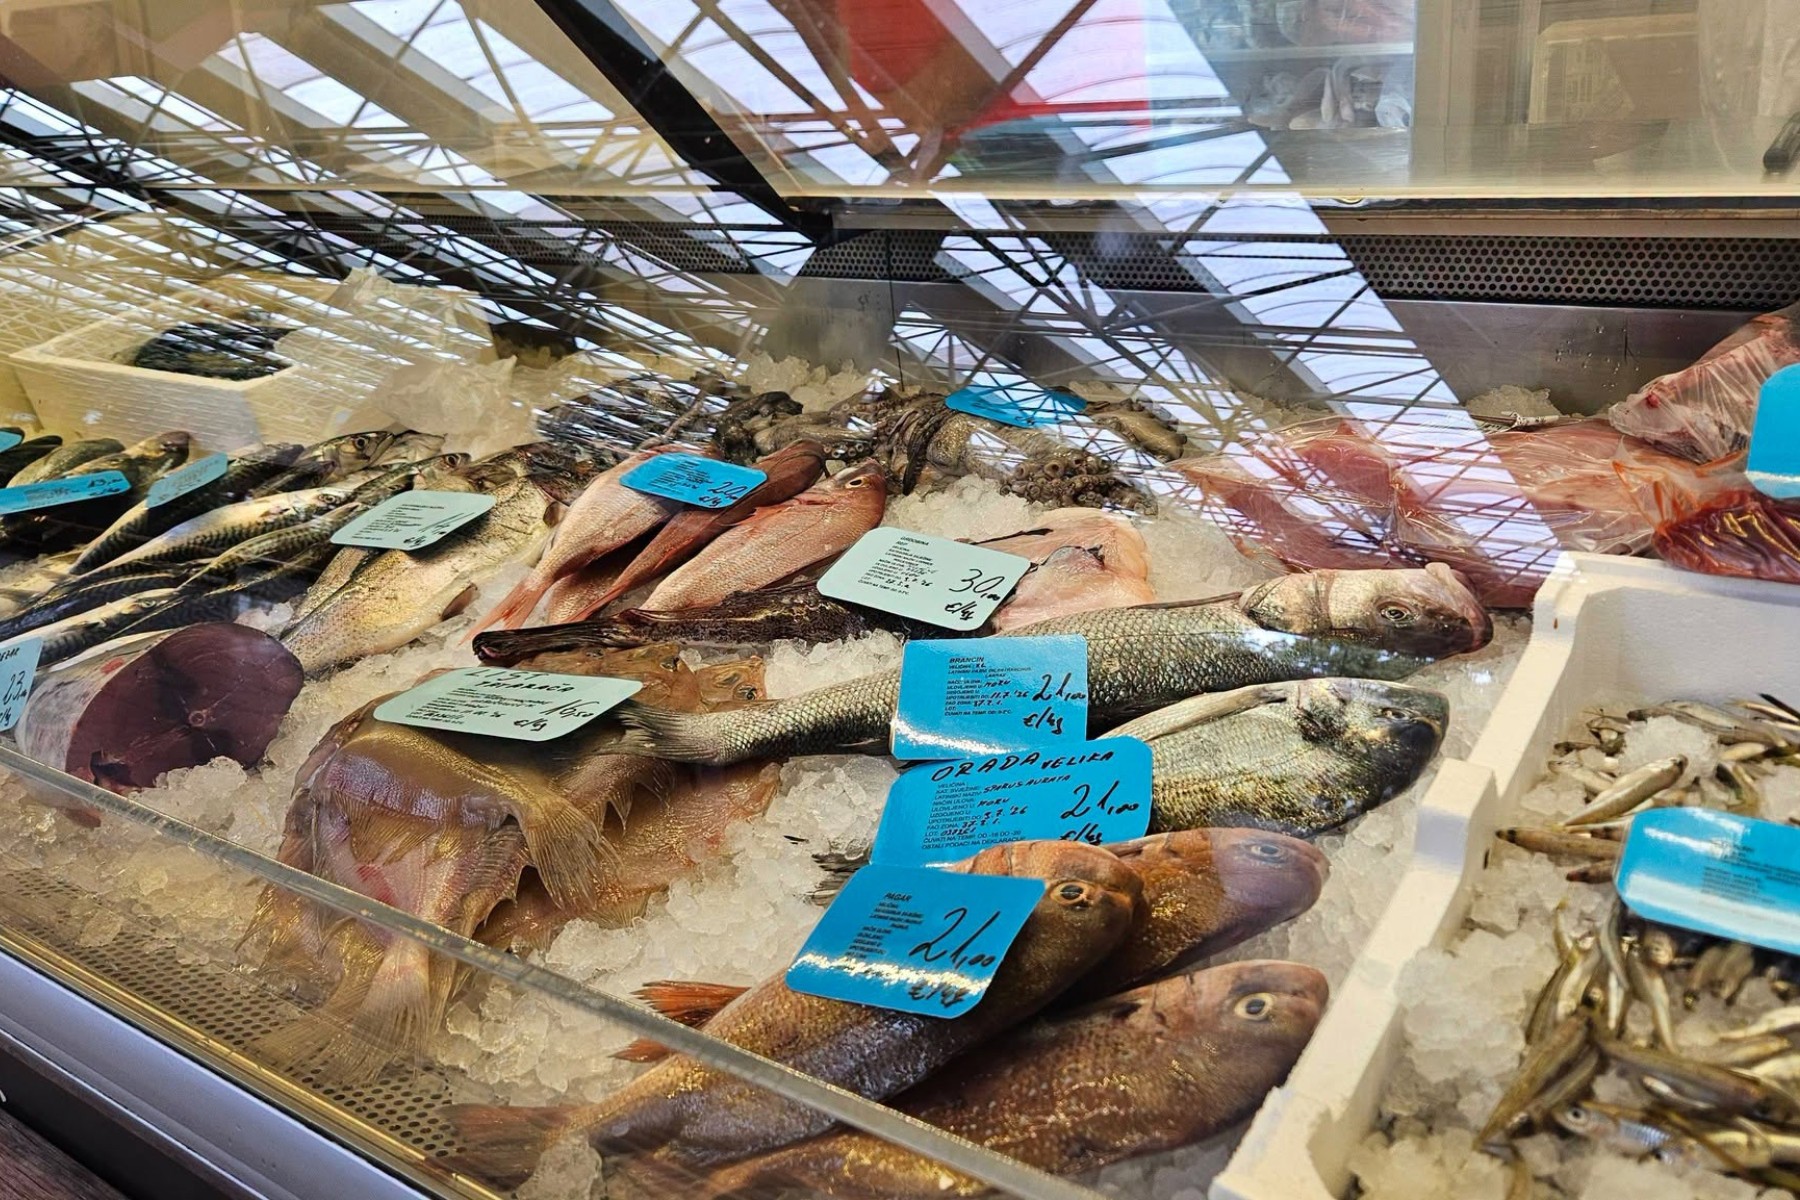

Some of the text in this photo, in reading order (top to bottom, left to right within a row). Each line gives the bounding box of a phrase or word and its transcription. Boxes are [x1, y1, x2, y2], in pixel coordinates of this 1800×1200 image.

[949, 656, 984, 664] BRANCIN
[931, 751, 1115, 782] ORADA VELIKA
[983, 781, 1023, 794] SPARUS
[1028, 774, 1071, 786] AURATA
